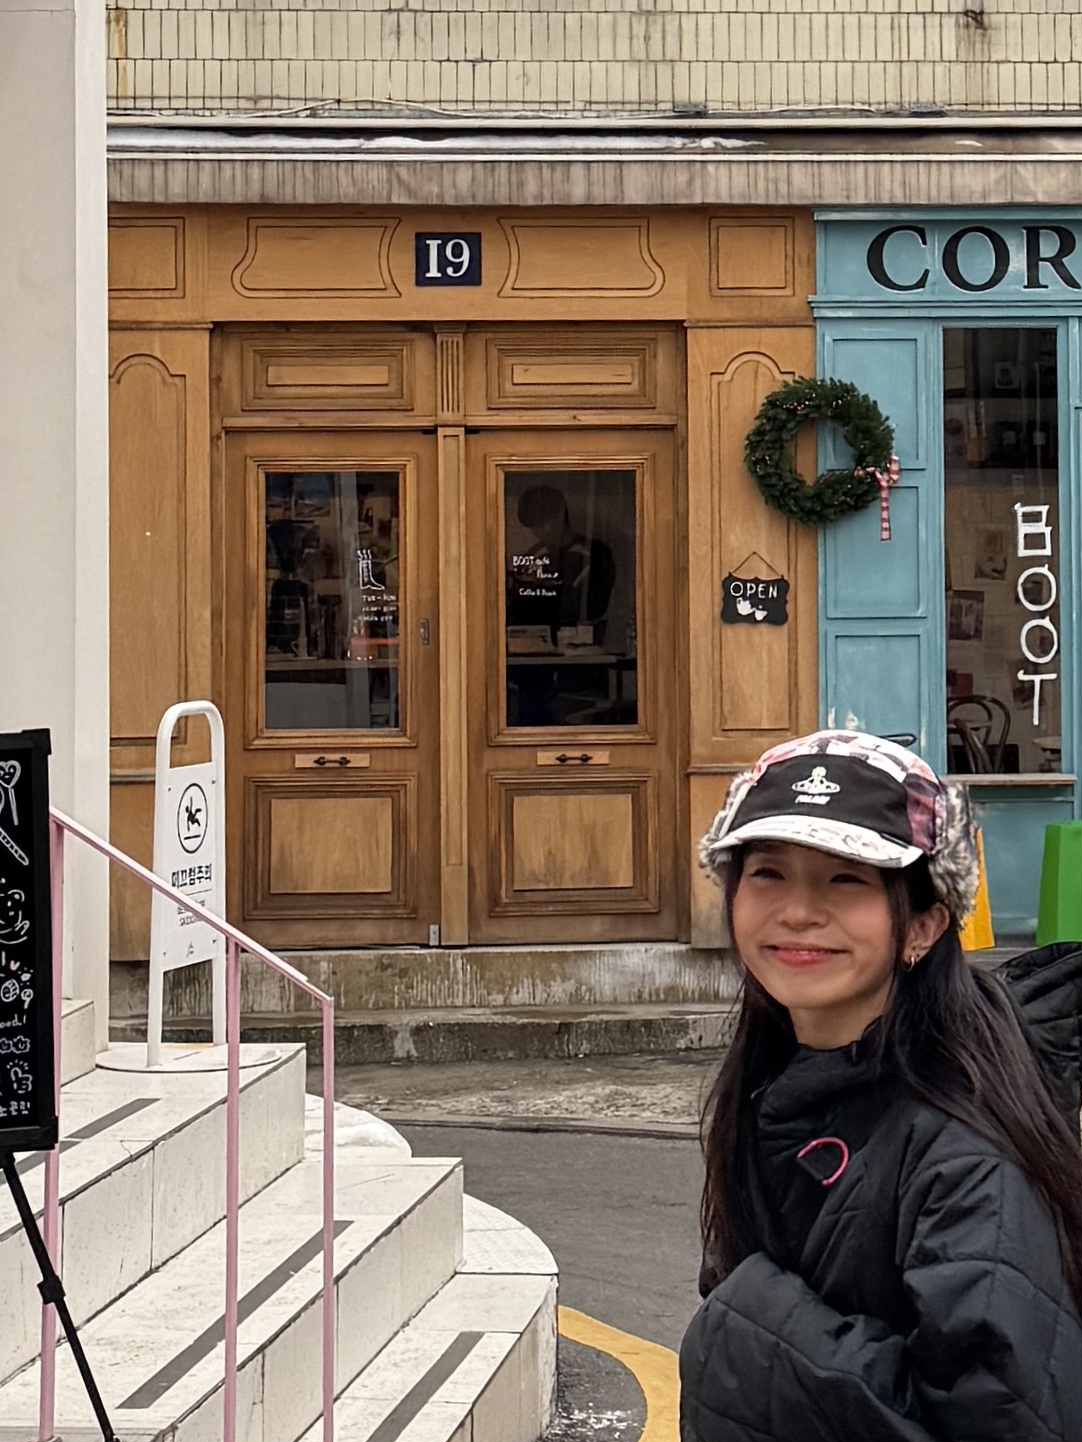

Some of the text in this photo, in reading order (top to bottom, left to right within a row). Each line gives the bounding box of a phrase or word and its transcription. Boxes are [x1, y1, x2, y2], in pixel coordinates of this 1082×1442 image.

[425, 238, 470, 278] 19
[730, 581, 778, 599] OPEN
[1014, 502, 1058, 726] BOOT
